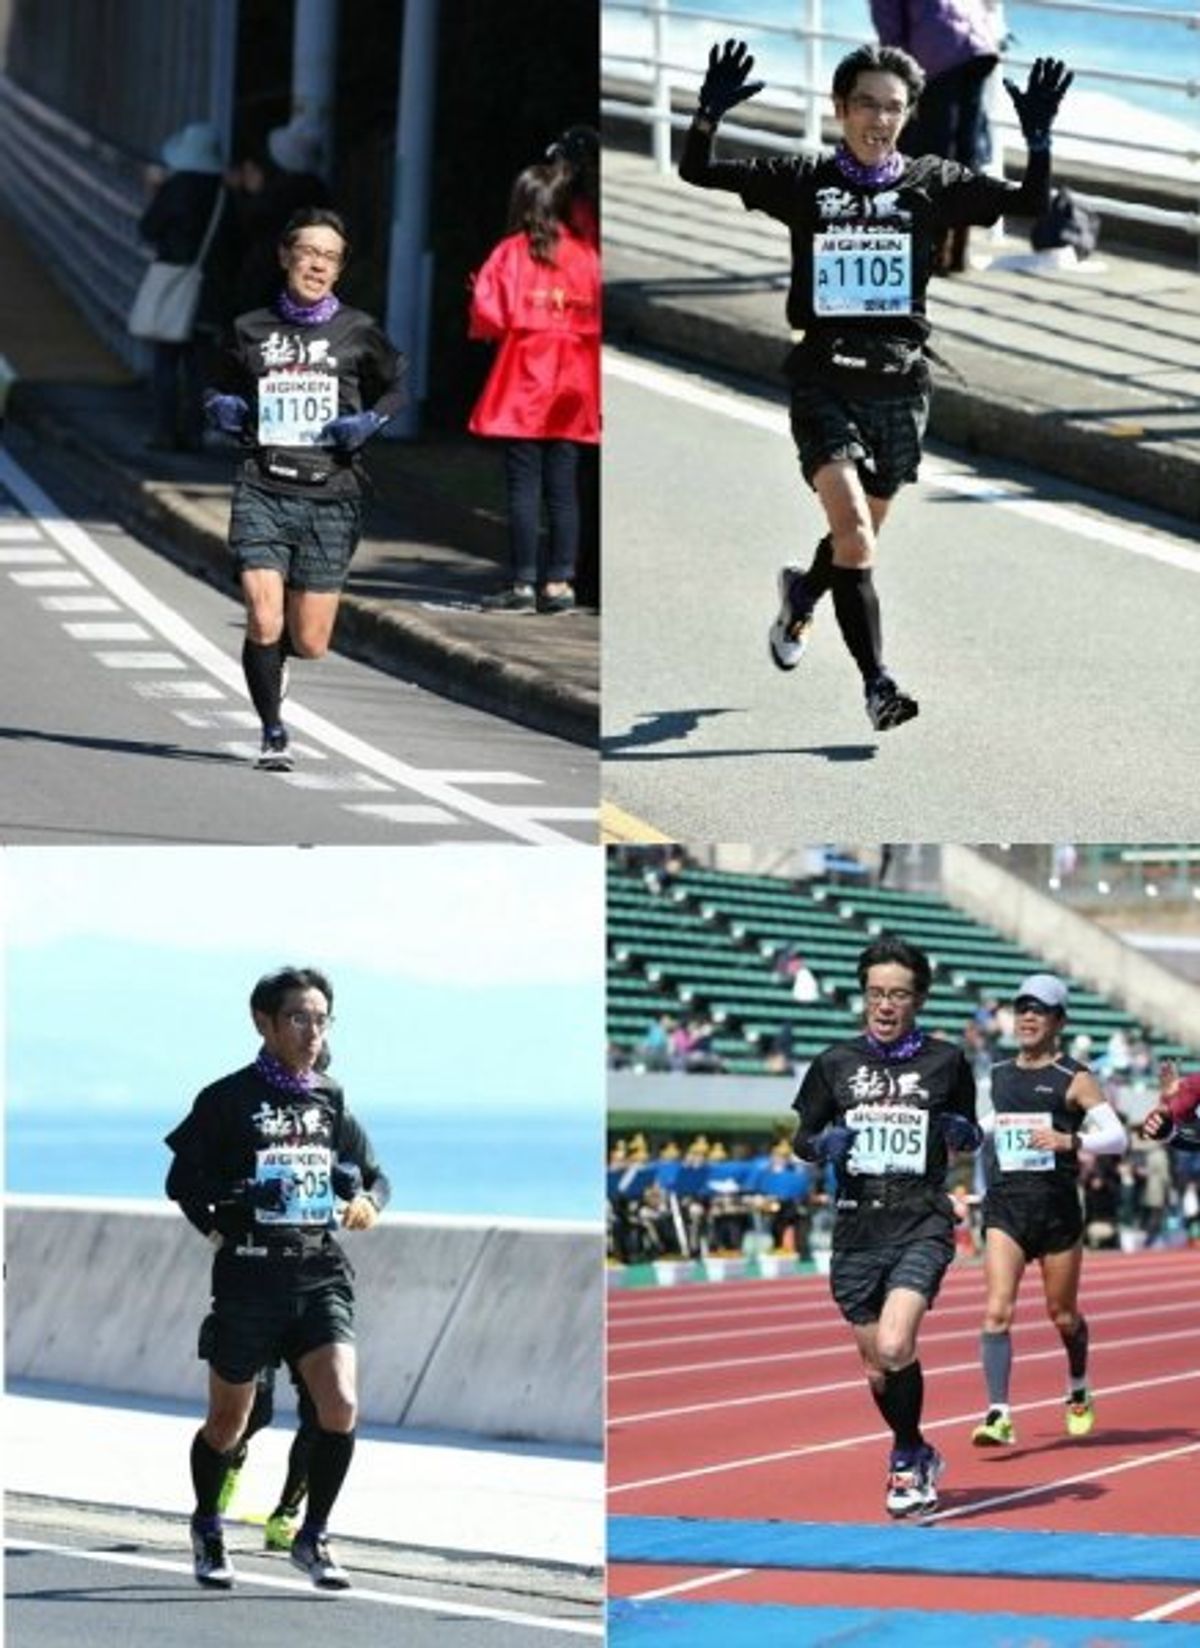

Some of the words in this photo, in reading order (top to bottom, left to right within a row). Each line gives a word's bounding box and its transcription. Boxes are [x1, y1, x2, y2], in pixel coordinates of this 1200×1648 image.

[834, 257, 905, 287] 1105
[275, 397, 333, 422] 1105
[864, 1126, 922, 1155] 1105
